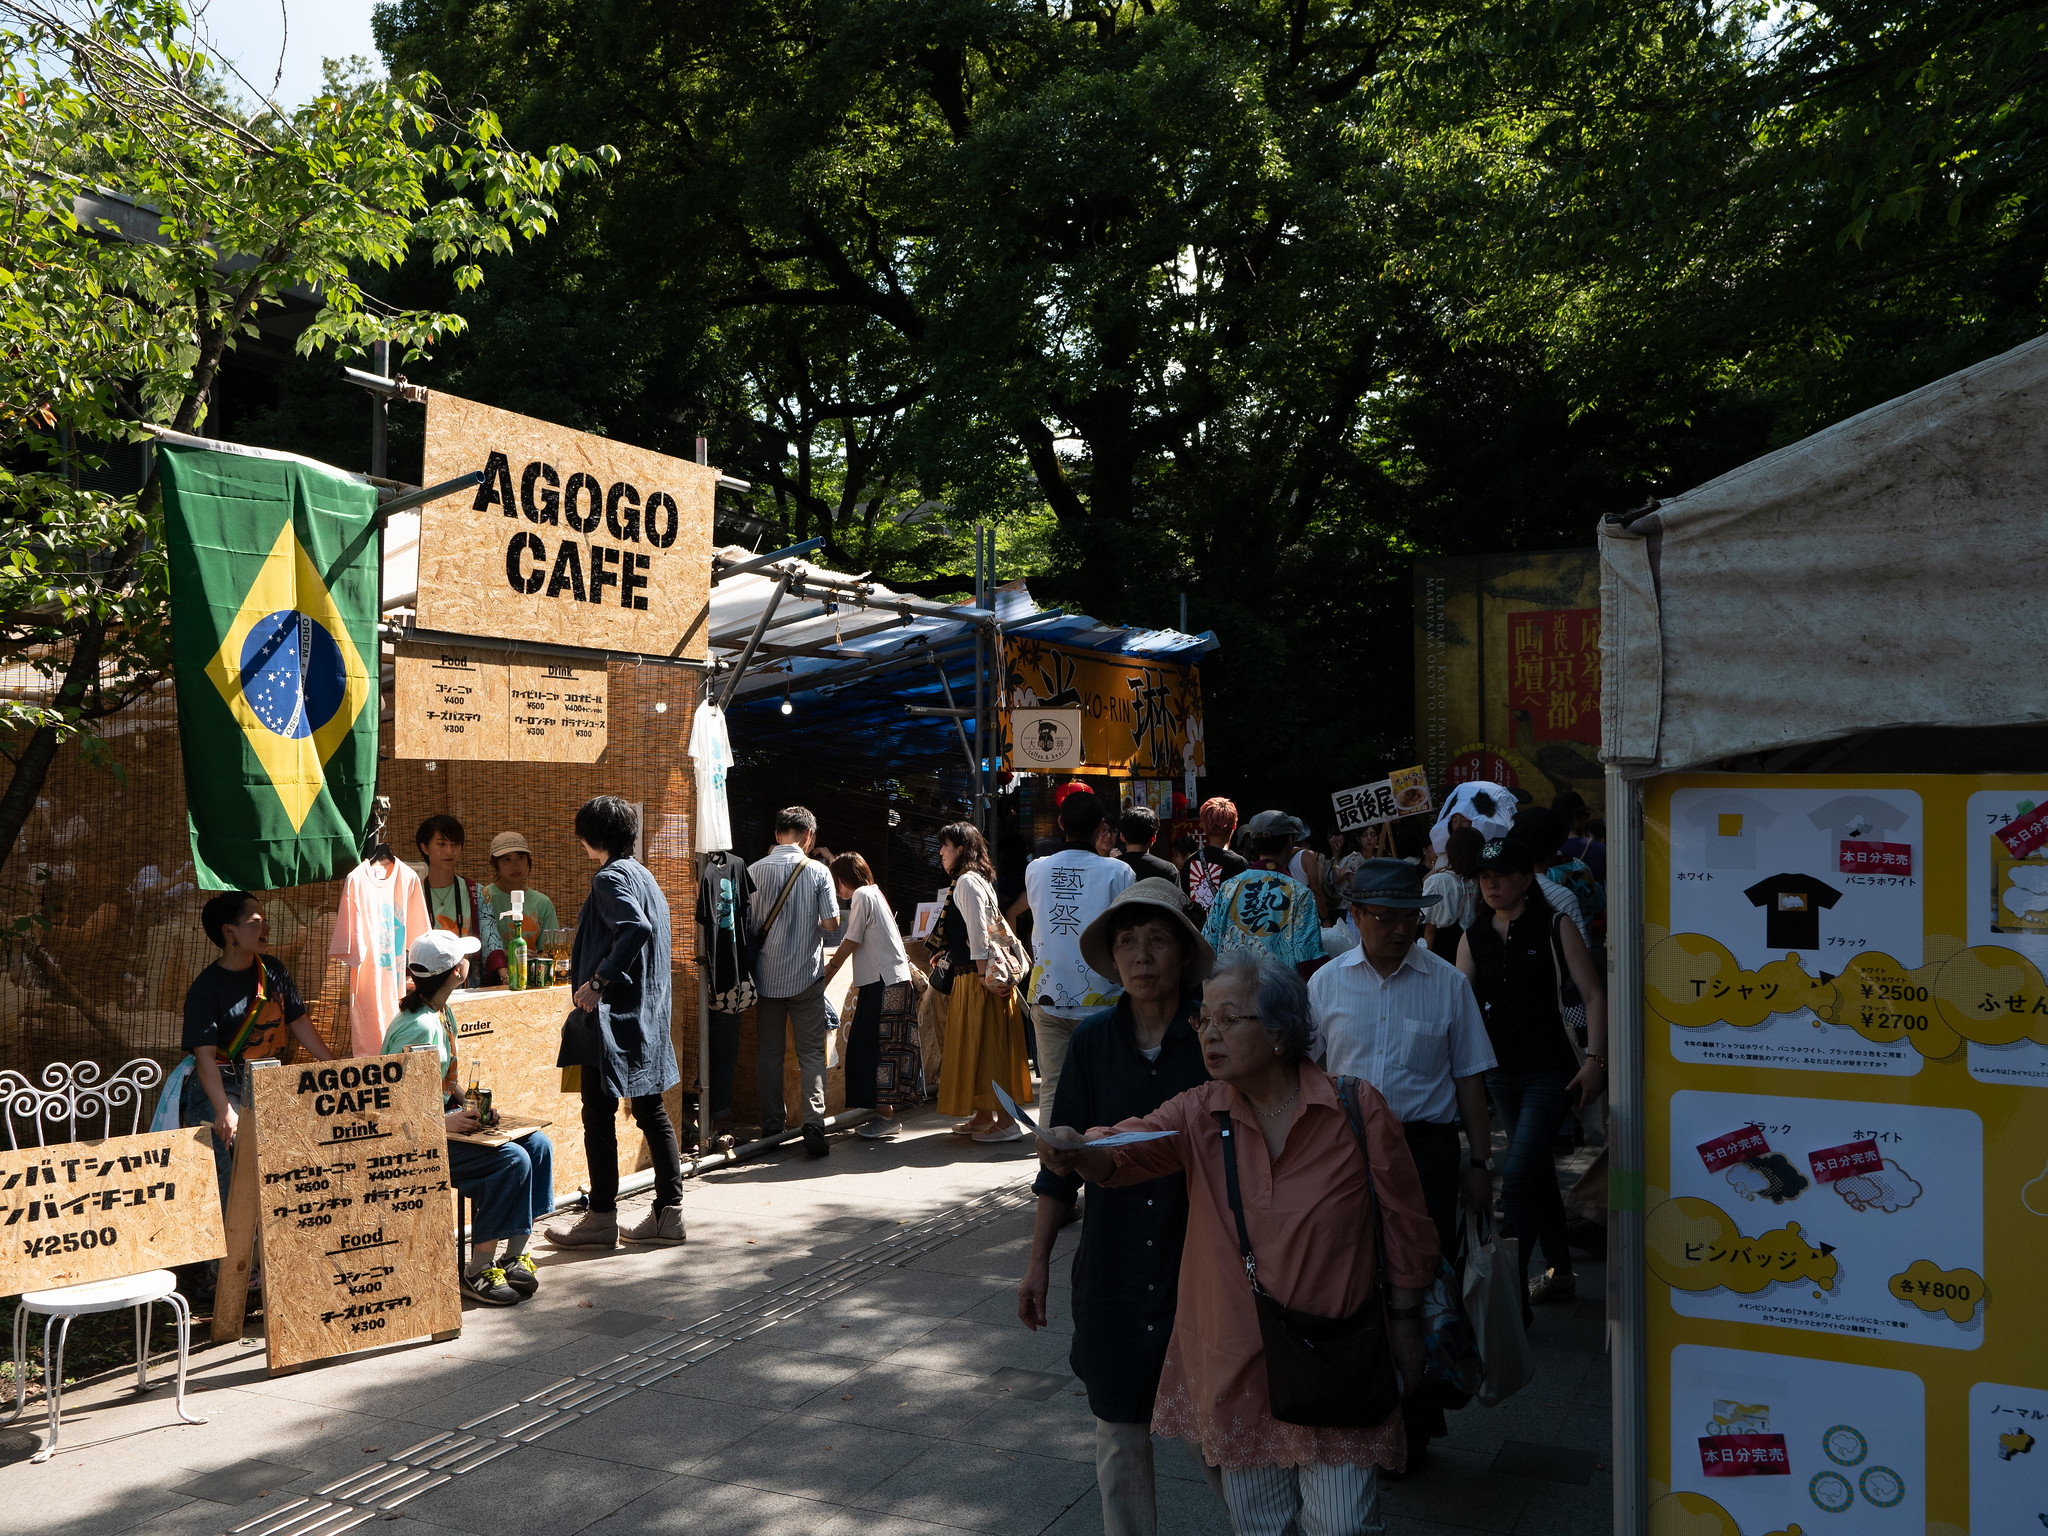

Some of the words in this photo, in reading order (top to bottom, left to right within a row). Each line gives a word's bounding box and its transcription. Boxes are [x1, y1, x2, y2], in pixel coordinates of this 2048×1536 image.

[472, 450, 679, 549] AGOGO
[506, 531, 650, 611] CAFE
[1426, 578, 1435, 649] MARUYAMA
[1436, 578, 1445, 657] LEGENDARY
[301, 618, 311, 658] ORDEM
[441, 655, 467, 668] Food
[548, 665, 573, 677] Drink
[1427, 654, 1436, 689] OKYO
[436, 683, 472, 695] コシーニャ
[512, 690, 560, 701] カイピリーニャ
[1437, 665, 1446, 709] KYOTO
[444, 696, 464, 705] ¥400
[527, 702, 545, 710] ¥500
[564, 692, 603, 704] コロナビール
[1085, 691, 1131, 723] KO-RIN
[1428, 695, 1436, 711] TO
[515, 716, 556, 726] ウーロンチャ
[561, 717, 606, 729] ガラナジュース
[1126, 667, 1177, 768] 琳
[444, 724, 464, 733] ¥300
[527, 728, 545, 736] ¥300
[575, 729, 592, 737] ¥300
[1428, 716, 1436, 740] THE
[1438, 717, 1447, 785] PAINTING
[1428, 746, 1437, 800] MODERN
[1335, 786, 1398, 830] 最後尾
[1843, 851, 1908, 865] 本日分完売
[1677, 872, 1713, 881] ホワイト
[1845, 877, 1916, 887] バニラホワイト
[1049, 866, 1085, 937] 藝祭
[1827, 937, 1866, 947] ブラック
[1690, 978, 1780, 1000] Tシャツ
[1861, 976, 1906, 984] バニラホワイト
[1861, 984, 1928, 1002] ¥2500
[461, 1021, 491, 1033] Order
[1861, 1013, 1928, 1031] ¥2700
[297, 1062, 403, 1095] AGOGO
[315, 1087, 391, 1116] CAFE
[333, 1121, 378, 1140] Drink
[1853, 1130, 1902, 1143] ホワイト
[366, 1148, 440, 1168] コロナビール
[1704, 1135, 1763, 1163] 本日分完売
[1814, 1150, 1878, 1172] 本日分完売
[264, 1162, 356, 1185] カイピリーニャ
[295, 1180, 330, 1193] ¥500
[363, 1180, 449, 1204] ガラナジュース
[273, 1198, 352, 1217] ウーロンチャ
[391, 1199, 423, 1213] ¥300
[297, 1214, 332, 1228] ¥300
[23, 1226, 117, 1259] ¥2500
[340, 1228, 383, 1248] Food
[1685, 1242, 1797, 1271] ピンバッジ
[333, 1266, 394, 1285] コシーニャ
[349, 1282, 382, 1296] ¥400
[1900, 1279, 1970, 1301] 各¥800
[351, 1318, 385, 1333] ¥300
[1990, 1405, 2048, 1420] ノーマル
[1704, 1448, 1784, 1463] 本日分完売
